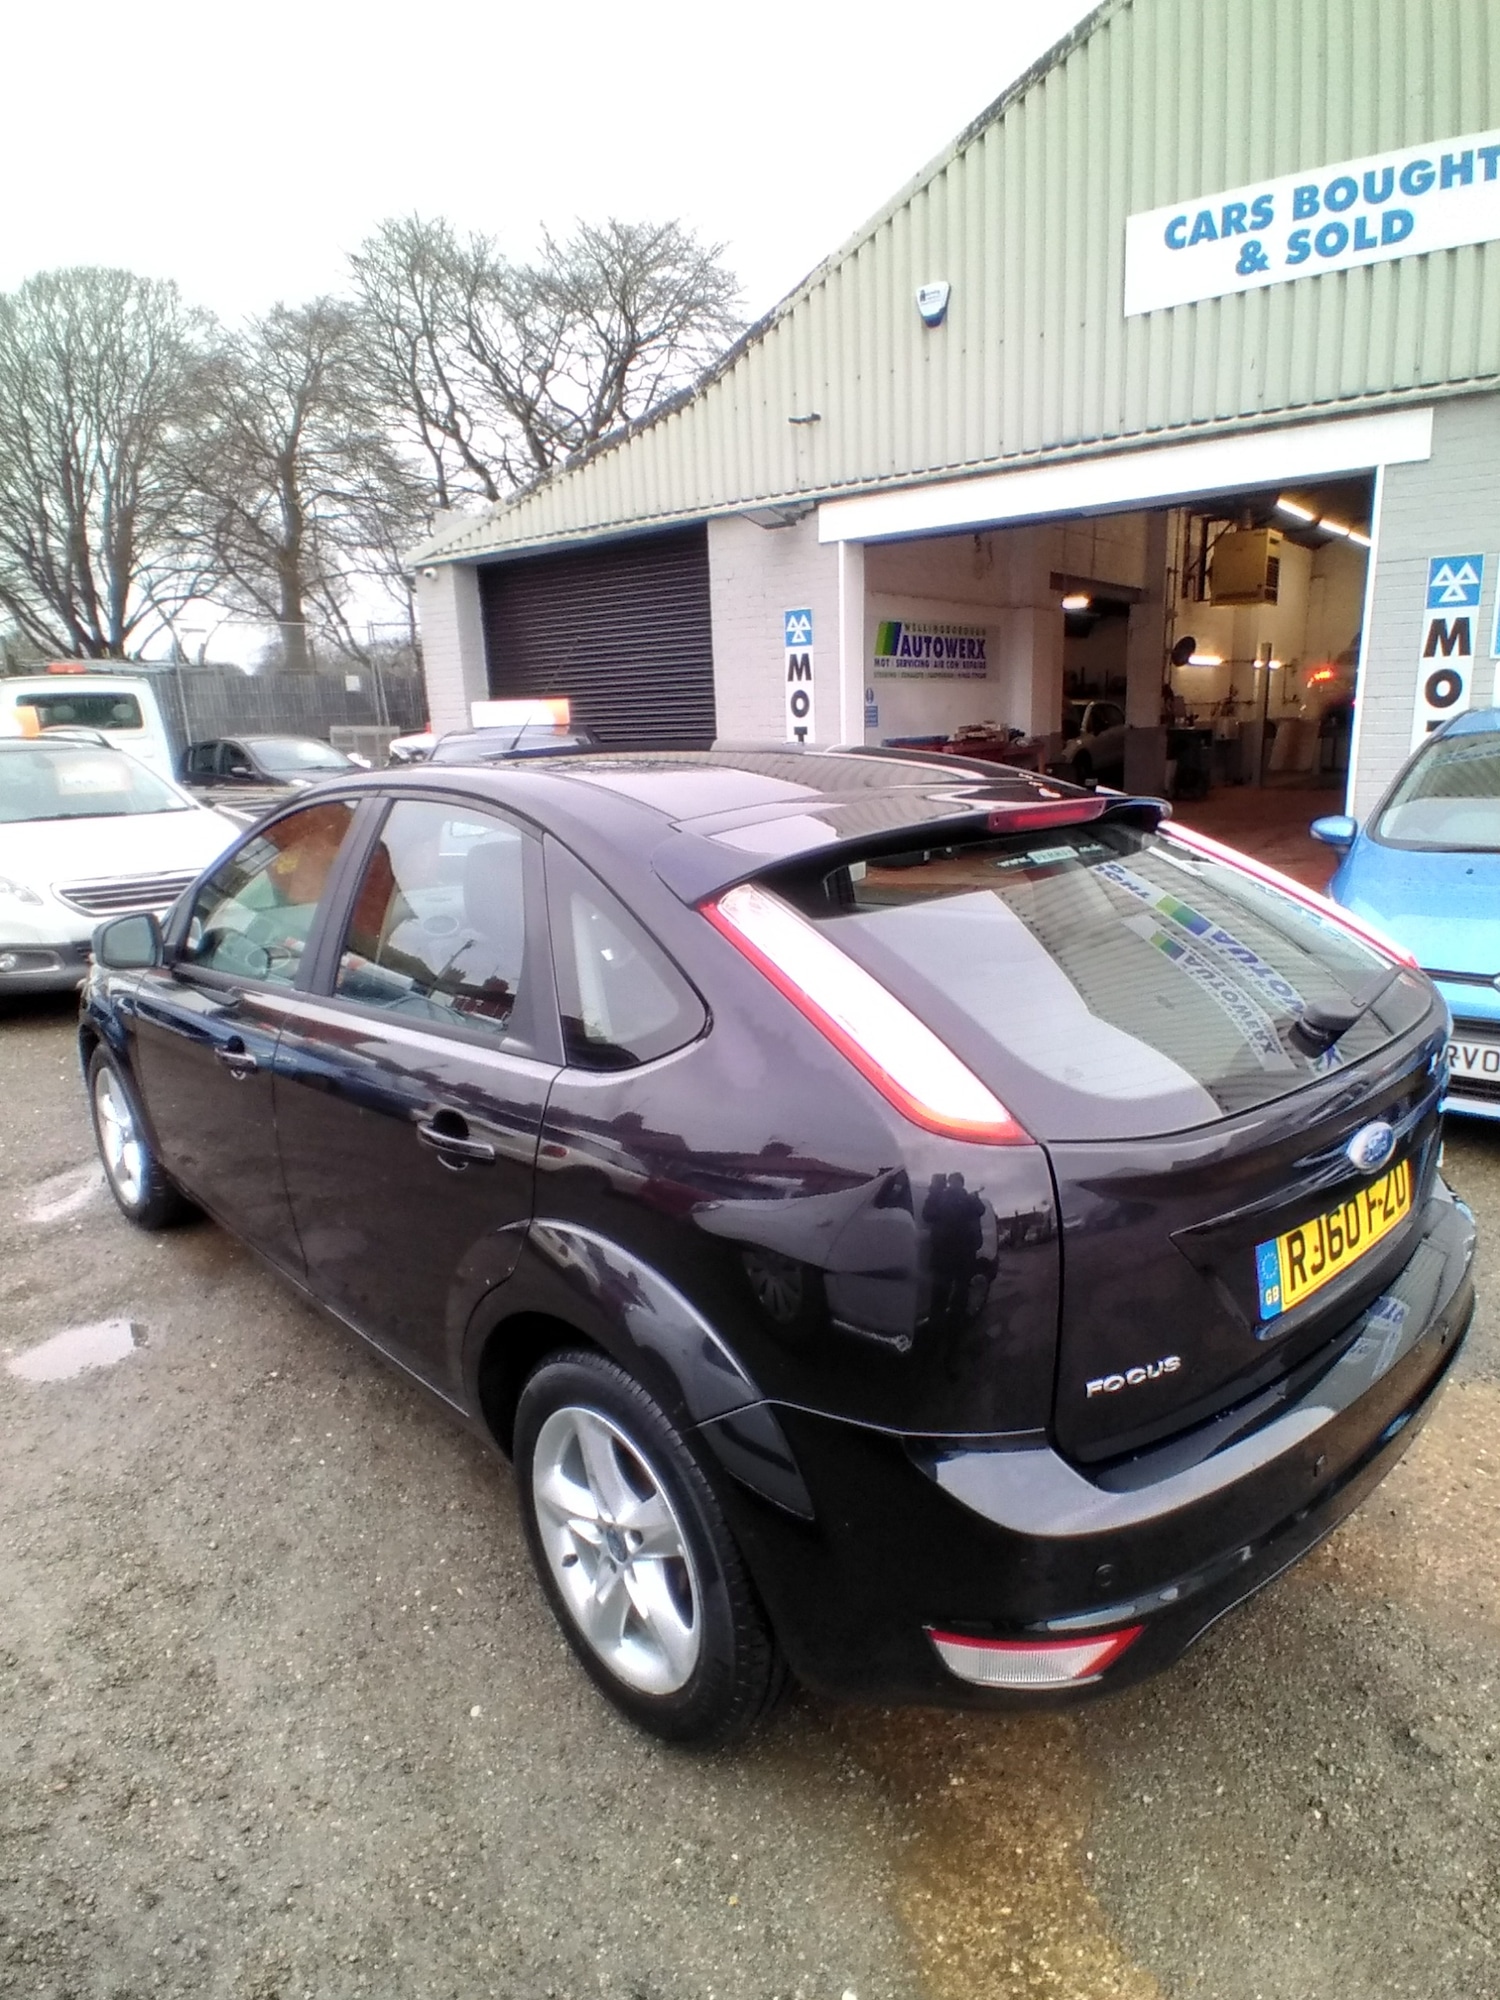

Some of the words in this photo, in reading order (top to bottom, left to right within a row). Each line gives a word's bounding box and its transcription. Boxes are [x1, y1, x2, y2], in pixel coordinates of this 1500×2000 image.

[1164, 194, 1274, 250] CARS
[1293, 144, 1500, 221] BOUGHT
[1236, 240, 1270, 275] &
[1285, 208, 1414, 264] SOLD
[900, 634, 986, 660] AUTOWERX
[1286, 1197, 1360, 1292] RJ60
[1265, 1285, 1279, 1305] GB
[1086, 1356, 1181, 1398] FOCUS
